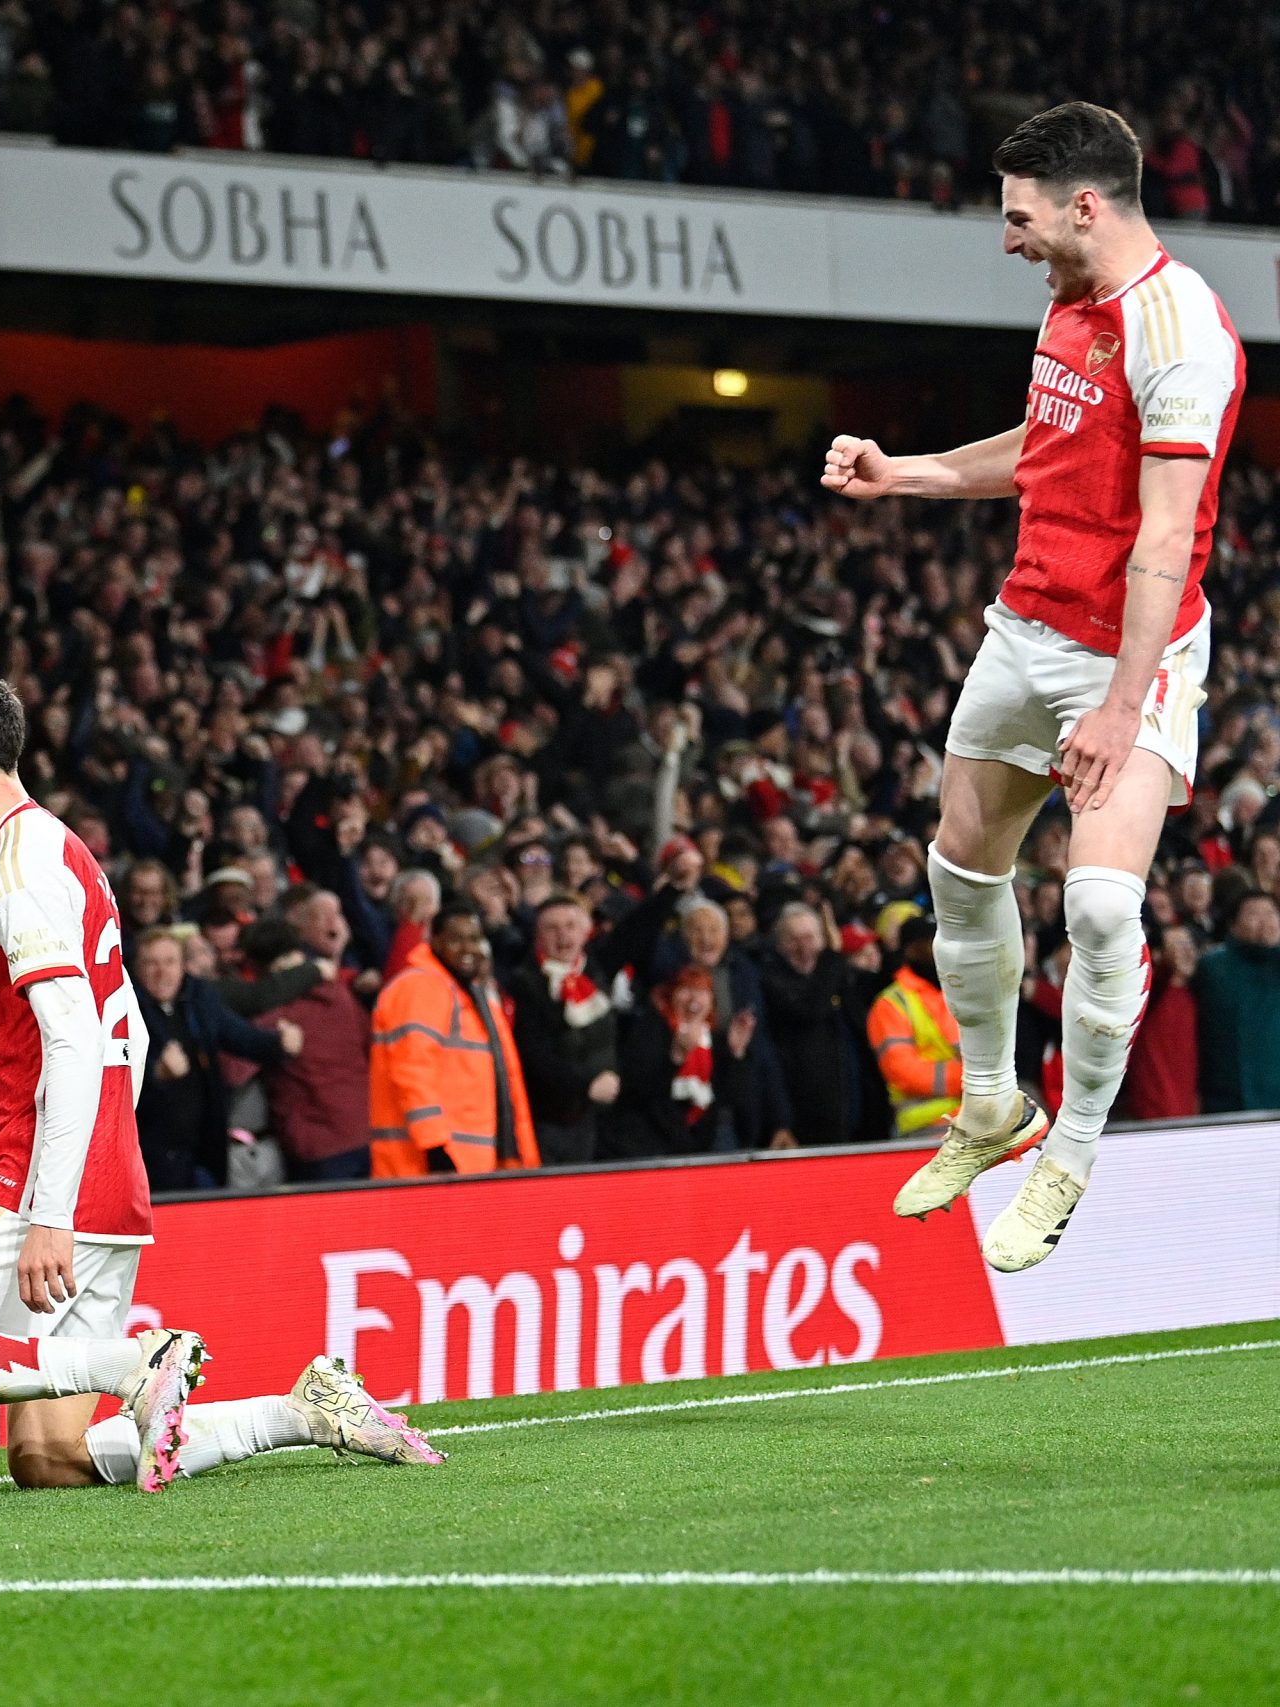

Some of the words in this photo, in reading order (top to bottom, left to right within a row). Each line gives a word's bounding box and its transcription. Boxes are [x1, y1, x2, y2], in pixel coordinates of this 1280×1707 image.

[109, 169, 389, 273] SOBHA
[490, 197, 744, 296] SOBHA
[1030, 353, 1104, 406] mirates
[1037, 393, 1083, 435] BETTER
[1157, 397, 1199, 411] VISIT
[321, 1224, 883, 1407] Emirates
